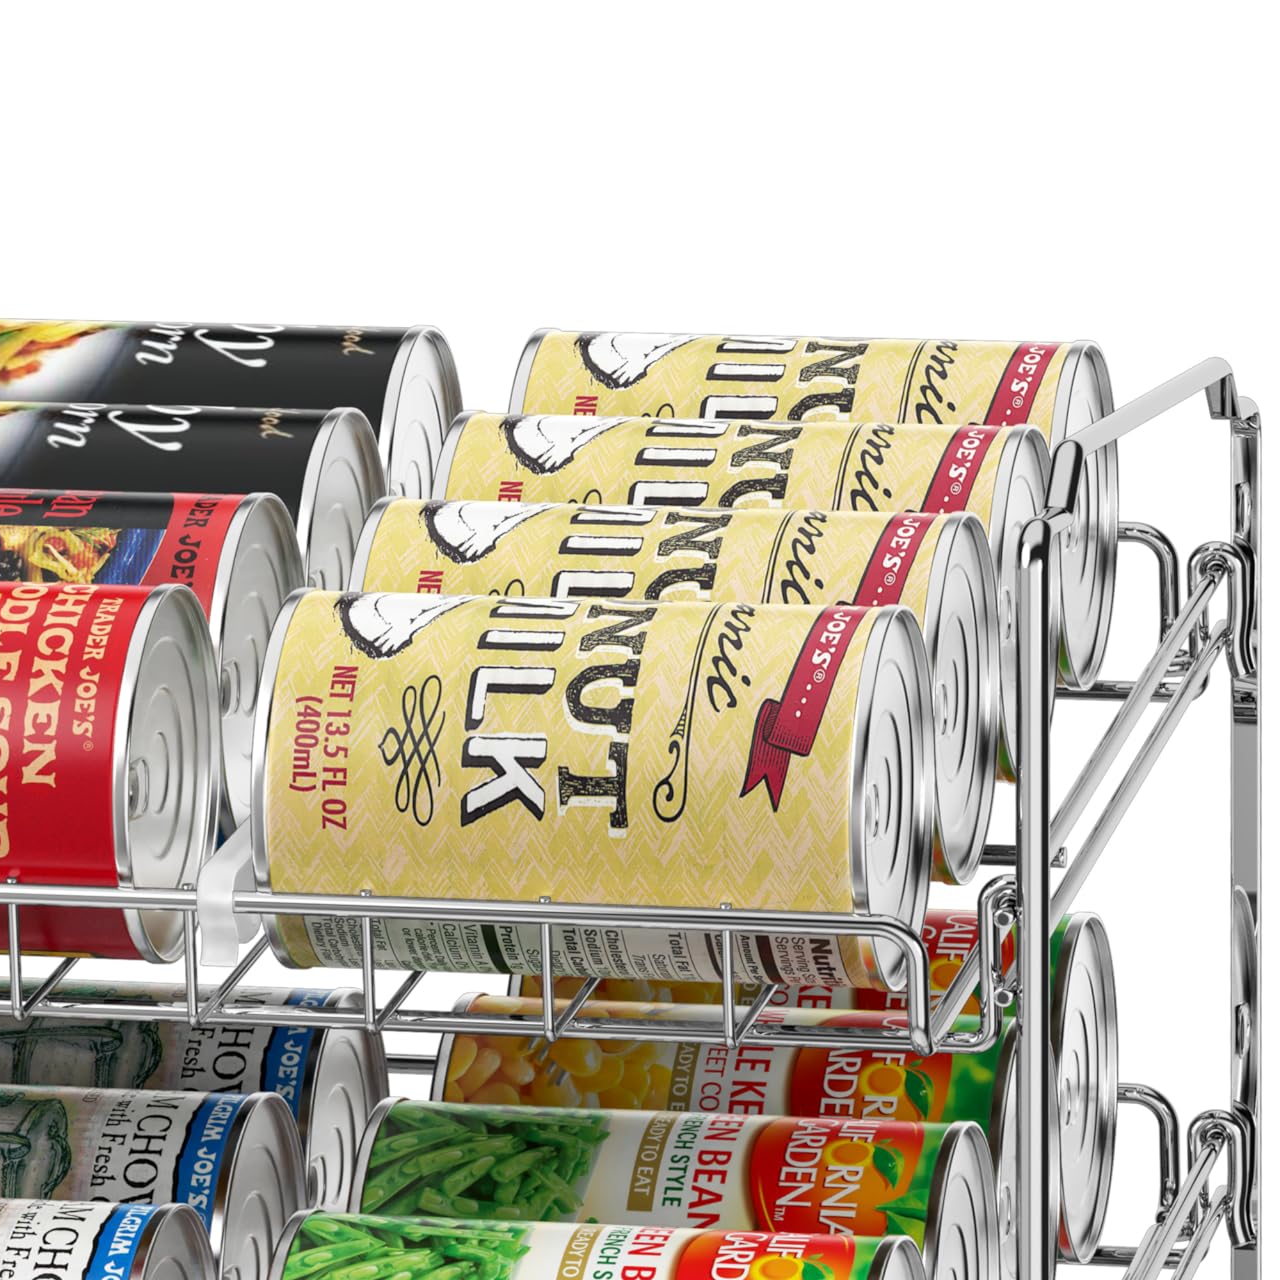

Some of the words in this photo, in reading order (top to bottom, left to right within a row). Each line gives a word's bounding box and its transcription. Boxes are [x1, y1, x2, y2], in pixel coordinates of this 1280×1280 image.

[83, 597, 123, 660] TRADER
[22, 584, 100, 787] CHICKEN
[329, 666, 359, 702] NET
[289, 695, 322, 794] (400mL)
[323, 711, 350, 759] 13.5
[321, 766, 348, 792] FL
[321, 799, 348, 830] OZ
[463, 924, 482, 960] Vitamin
[500, 925, 520, 960] Protein
[641, 1143, 660, 1161] TO
[634, 1166, 654, 1197] EAT
[661, 1155, 690, 1208] STYLE
[10, 1212, 40, 1240] with
[562, 1260, 582, 1278] TO
